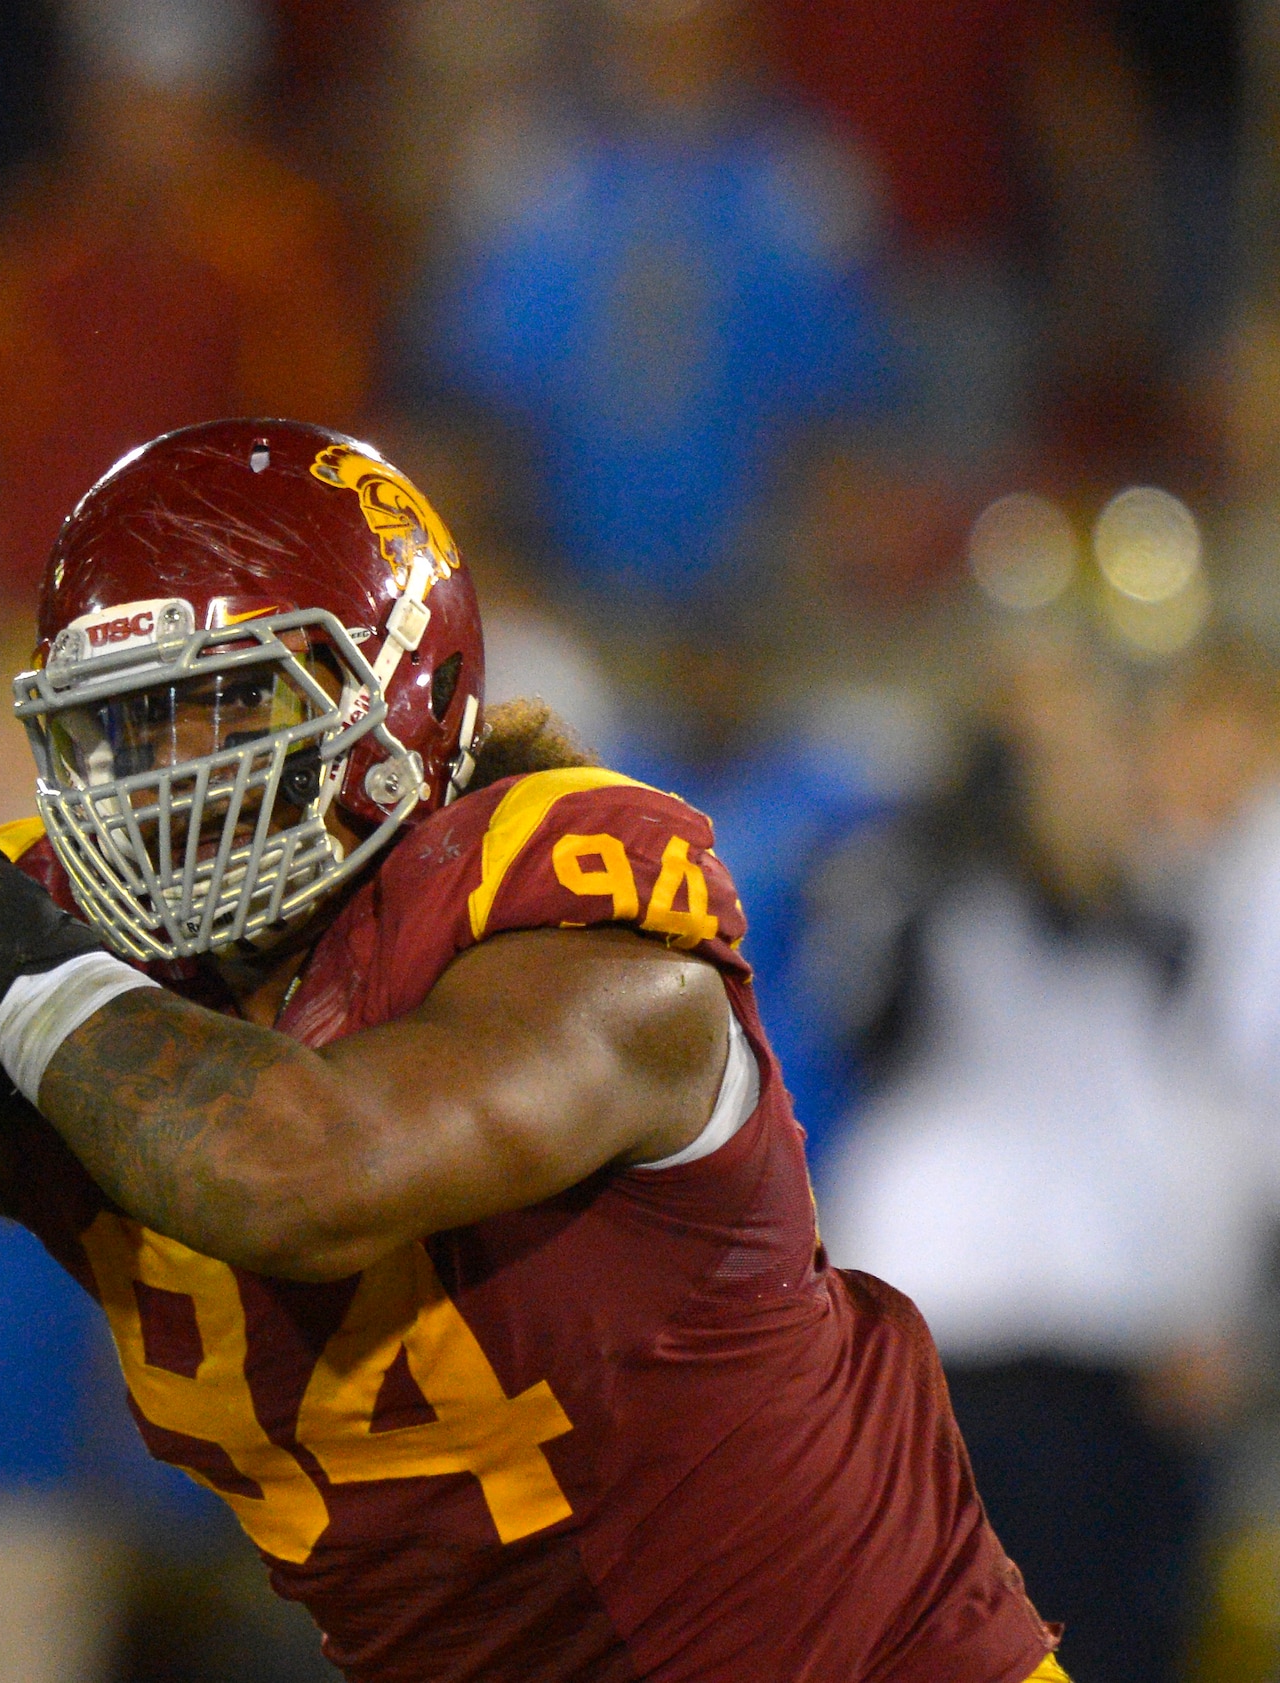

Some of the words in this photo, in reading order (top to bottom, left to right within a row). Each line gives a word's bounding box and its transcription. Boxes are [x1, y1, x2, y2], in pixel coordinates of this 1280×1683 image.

[85, 611, 155, 648] USC
[552, 832, 719, 949] 94
[81, 1210, 574, 1565] 94
